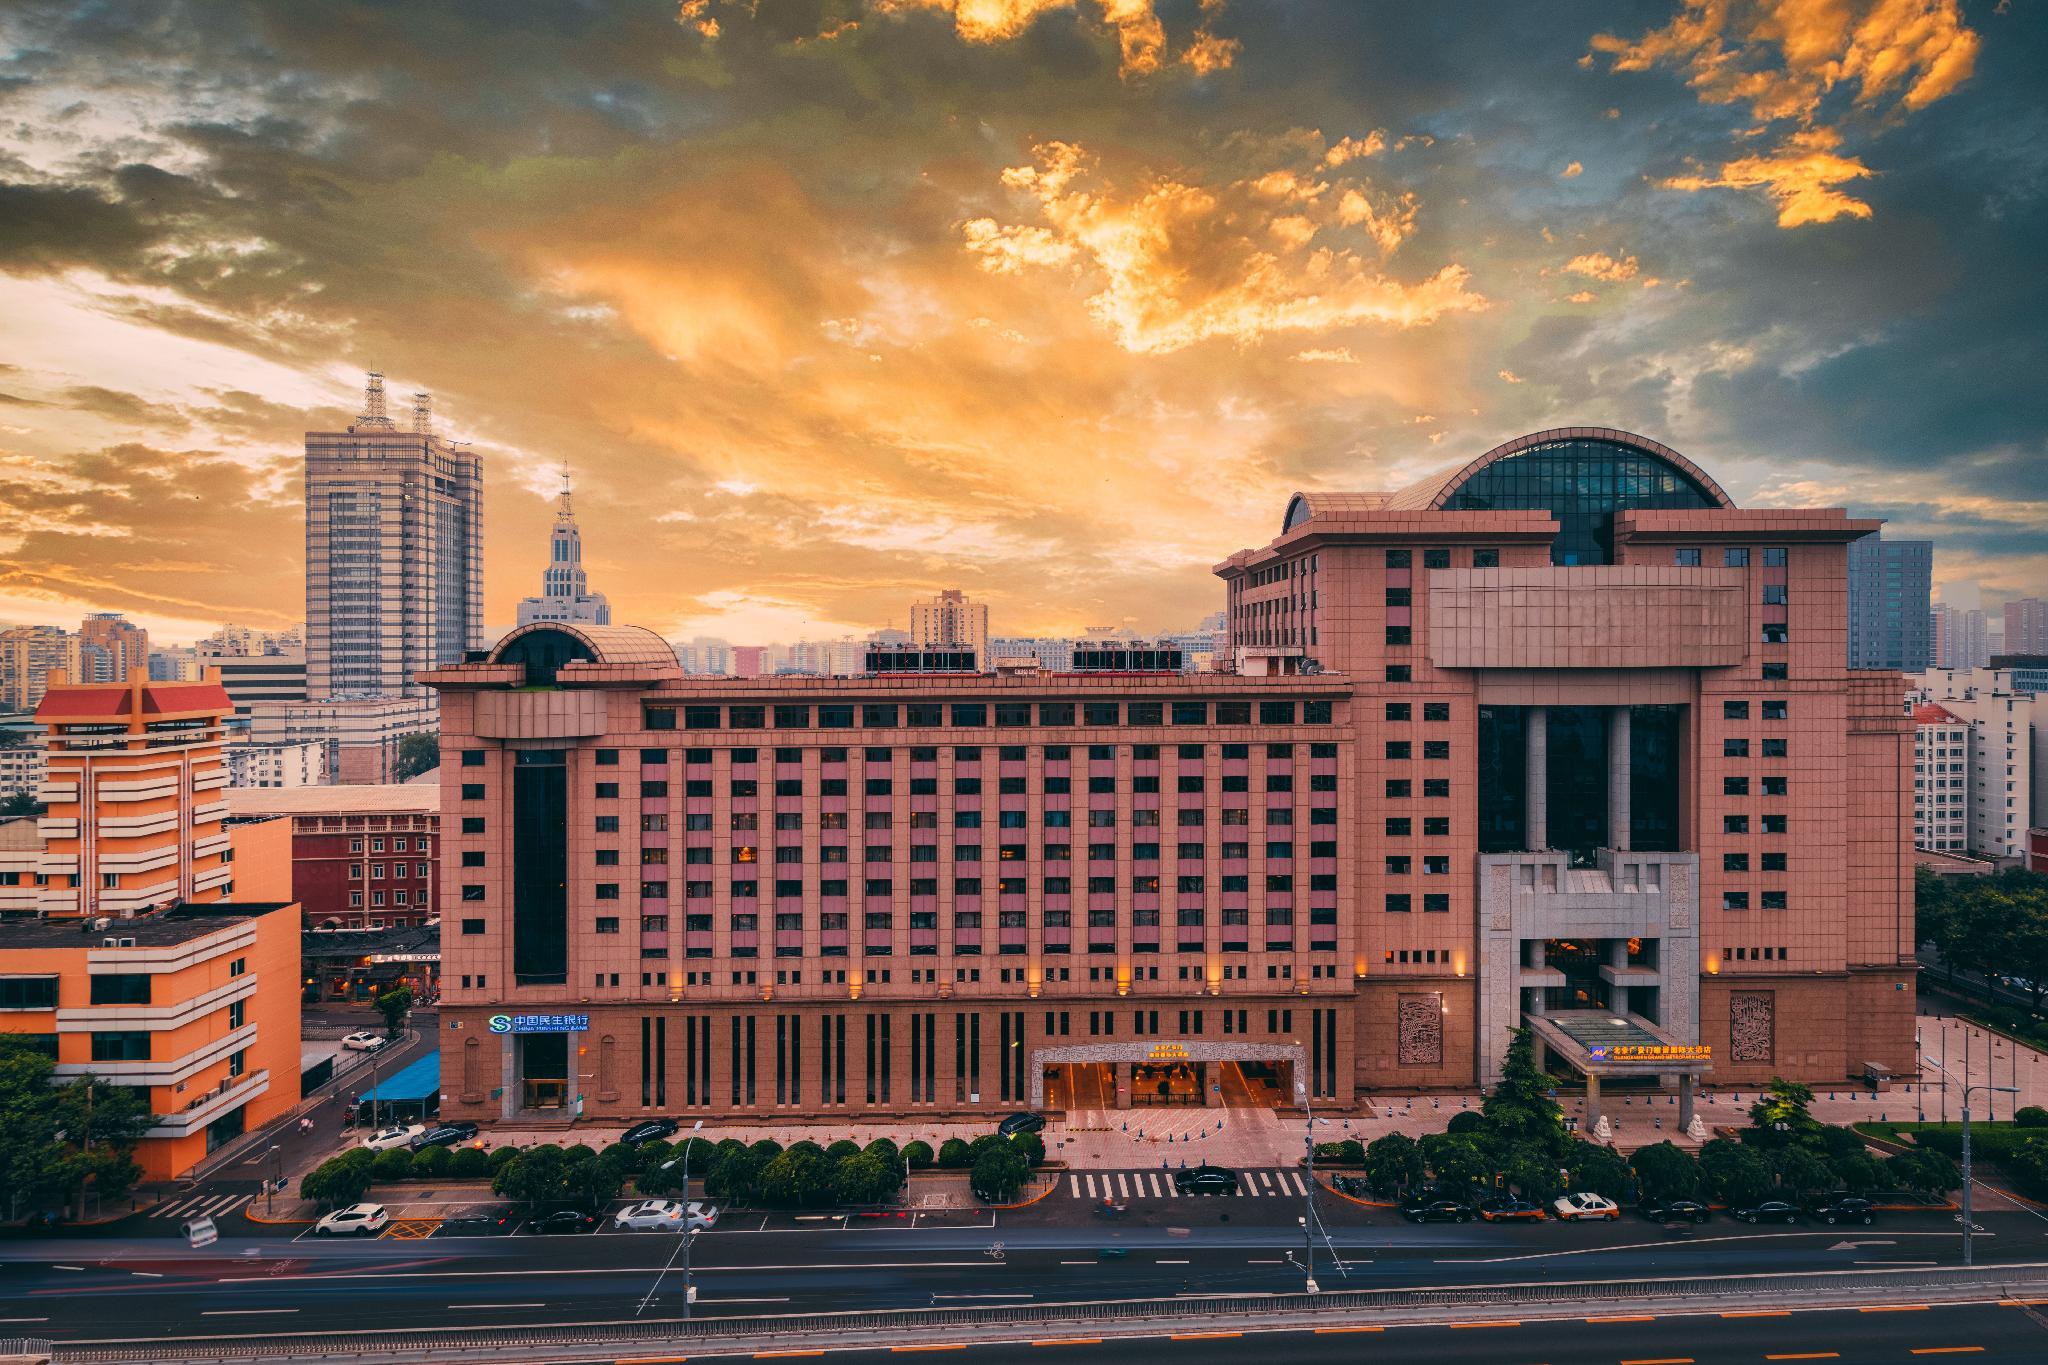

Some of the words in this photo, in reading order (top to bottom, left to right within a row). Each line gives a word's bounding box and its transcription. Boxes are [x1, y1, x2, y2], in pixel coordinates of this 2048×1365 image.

[514, 1015, 589, 1026] 中国民生银行
